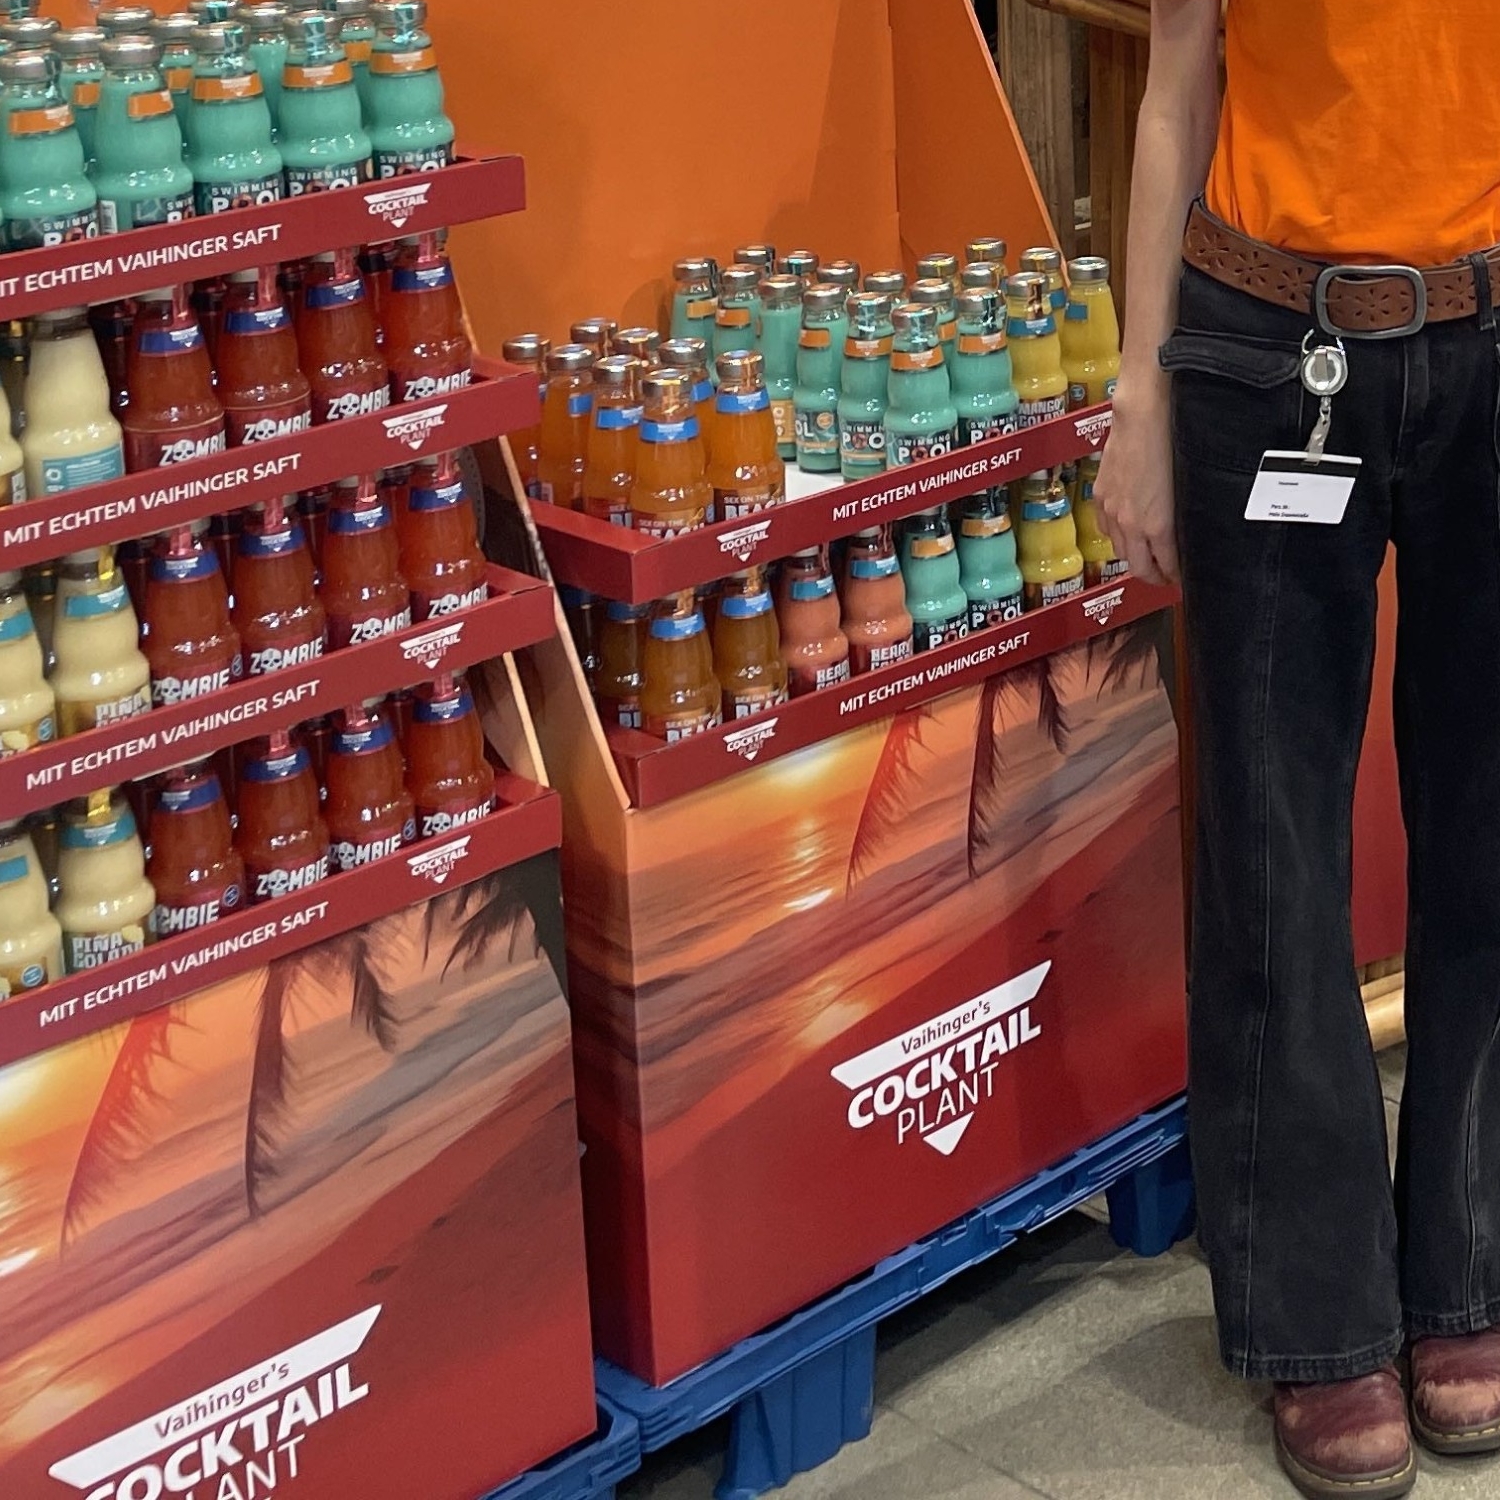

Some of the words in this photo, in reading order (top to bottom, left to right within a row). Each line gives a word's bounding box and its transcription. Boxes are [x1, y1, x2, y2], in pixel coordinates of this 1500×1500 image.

[380, 149, 445, 164] SWIMMING
[212, 177, 279, 195] SWIMMING
[288, 167, 357, 180] SWIMMING
[368, 192, 428, 215] COCKTAIL
[383, 206, 415, 222] PLANT
[0, 278, 19, 297] IT
[24, 259, 114, 293] ECHTEM
[117, 235, 228, 274] VAIHINGER
[232, 223, 282, 250] SAFT
[404, 368, 472, 401] ZOMBIE
[1019, 396, 1065, 415] MANGO
[242, 410, 312, 445] ZOMBIE
[387, 416, 445, 439] COCKTAIL
[401, 429, 431, 445] PLANT
[832, 502, 857, 521] MIT
[861, 481, 917, 511] ECHTEM
[918, 459, 988, 497] VAIHINGER
[990, 448, 1023, 468] SAFT
[3, 520, 44, 548] MIT
[49, 496, 137, 536] ECHTEM
[140, 467, 249, 511] VAIHINGER
[253, 453, 302, 481] SAFT
[720, 530, 769, 552] COCKTAIL
[732, 541, 757, 557] PLANT
[1084, 597, 1122, 617] COCKTAIL
[250, 636, 323, 676] ZOMBIE
[404, 633, 462, 660] COCKTAIL
[417, 647, 448, 665] PLANT
[152, 668, 230, 706] ZOMBIE
[839, 696, 864, 715] MIT
[868, 674, 924, 704] ECHTEM
[927, 645, 996, 682] VAIHINGER
[998, 631, 1031, 654] SAFT
[27, 762, 66, 791] MIT
[71, 733, 156, 776] ECHTEM
[161, 698, 268, 746] VAIHINGER
[272, 679, 320, 709] SAFT
[727, 727, 776, 753] COCKTAIL
[423, 801, 491, 837] ZOMBIE
[255, 855, 329, 898] ZOMBIE
[411, 847, 469, 877] COCKTAIL
[425, 861, 455, 880] PLANT
[72, 931, 123, 954] PIÑA
[40, 998, 80, 1027] MIT
[83, 964, 168, 1011] ECHTEM
[171, 922, 278, 976] VAIHINGER
[281, 901, 330, 933] SAFT
[901, 1001, 991, 1054] Vaihinger's
[848, 1006, 1042, 1129] COCKTAIL
[898, 1061, 999, 1145] PLANT
[153, 1360, 291, 1439] Vaihinger's
